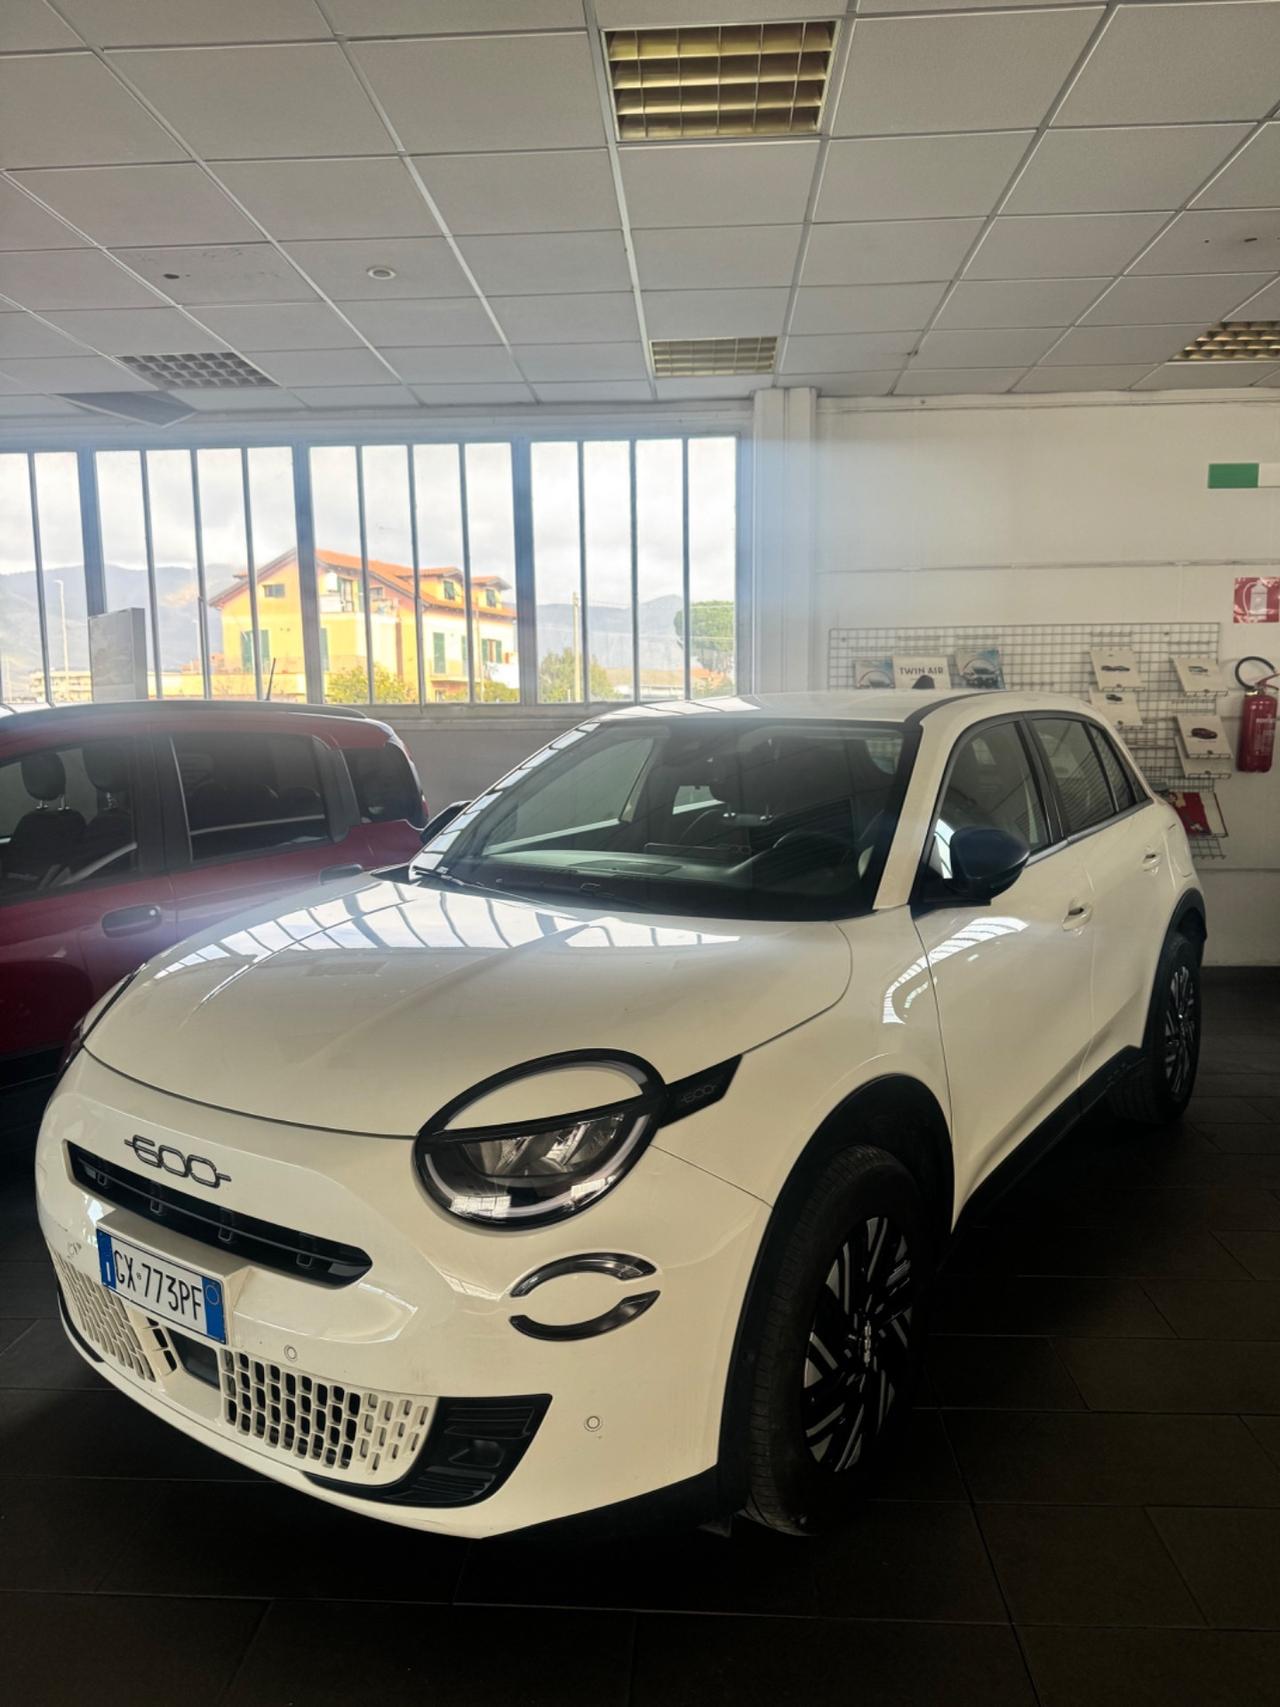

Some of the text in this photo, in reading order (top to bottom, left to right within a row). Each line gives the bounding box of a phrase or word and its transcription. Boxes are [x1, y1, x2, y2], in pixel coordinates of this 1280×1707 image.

[900, 666, 944, 675] TWIN AIR
[124, 1134, 232, 1189] 600
[141, 1263, 202, 1320] 773PF
